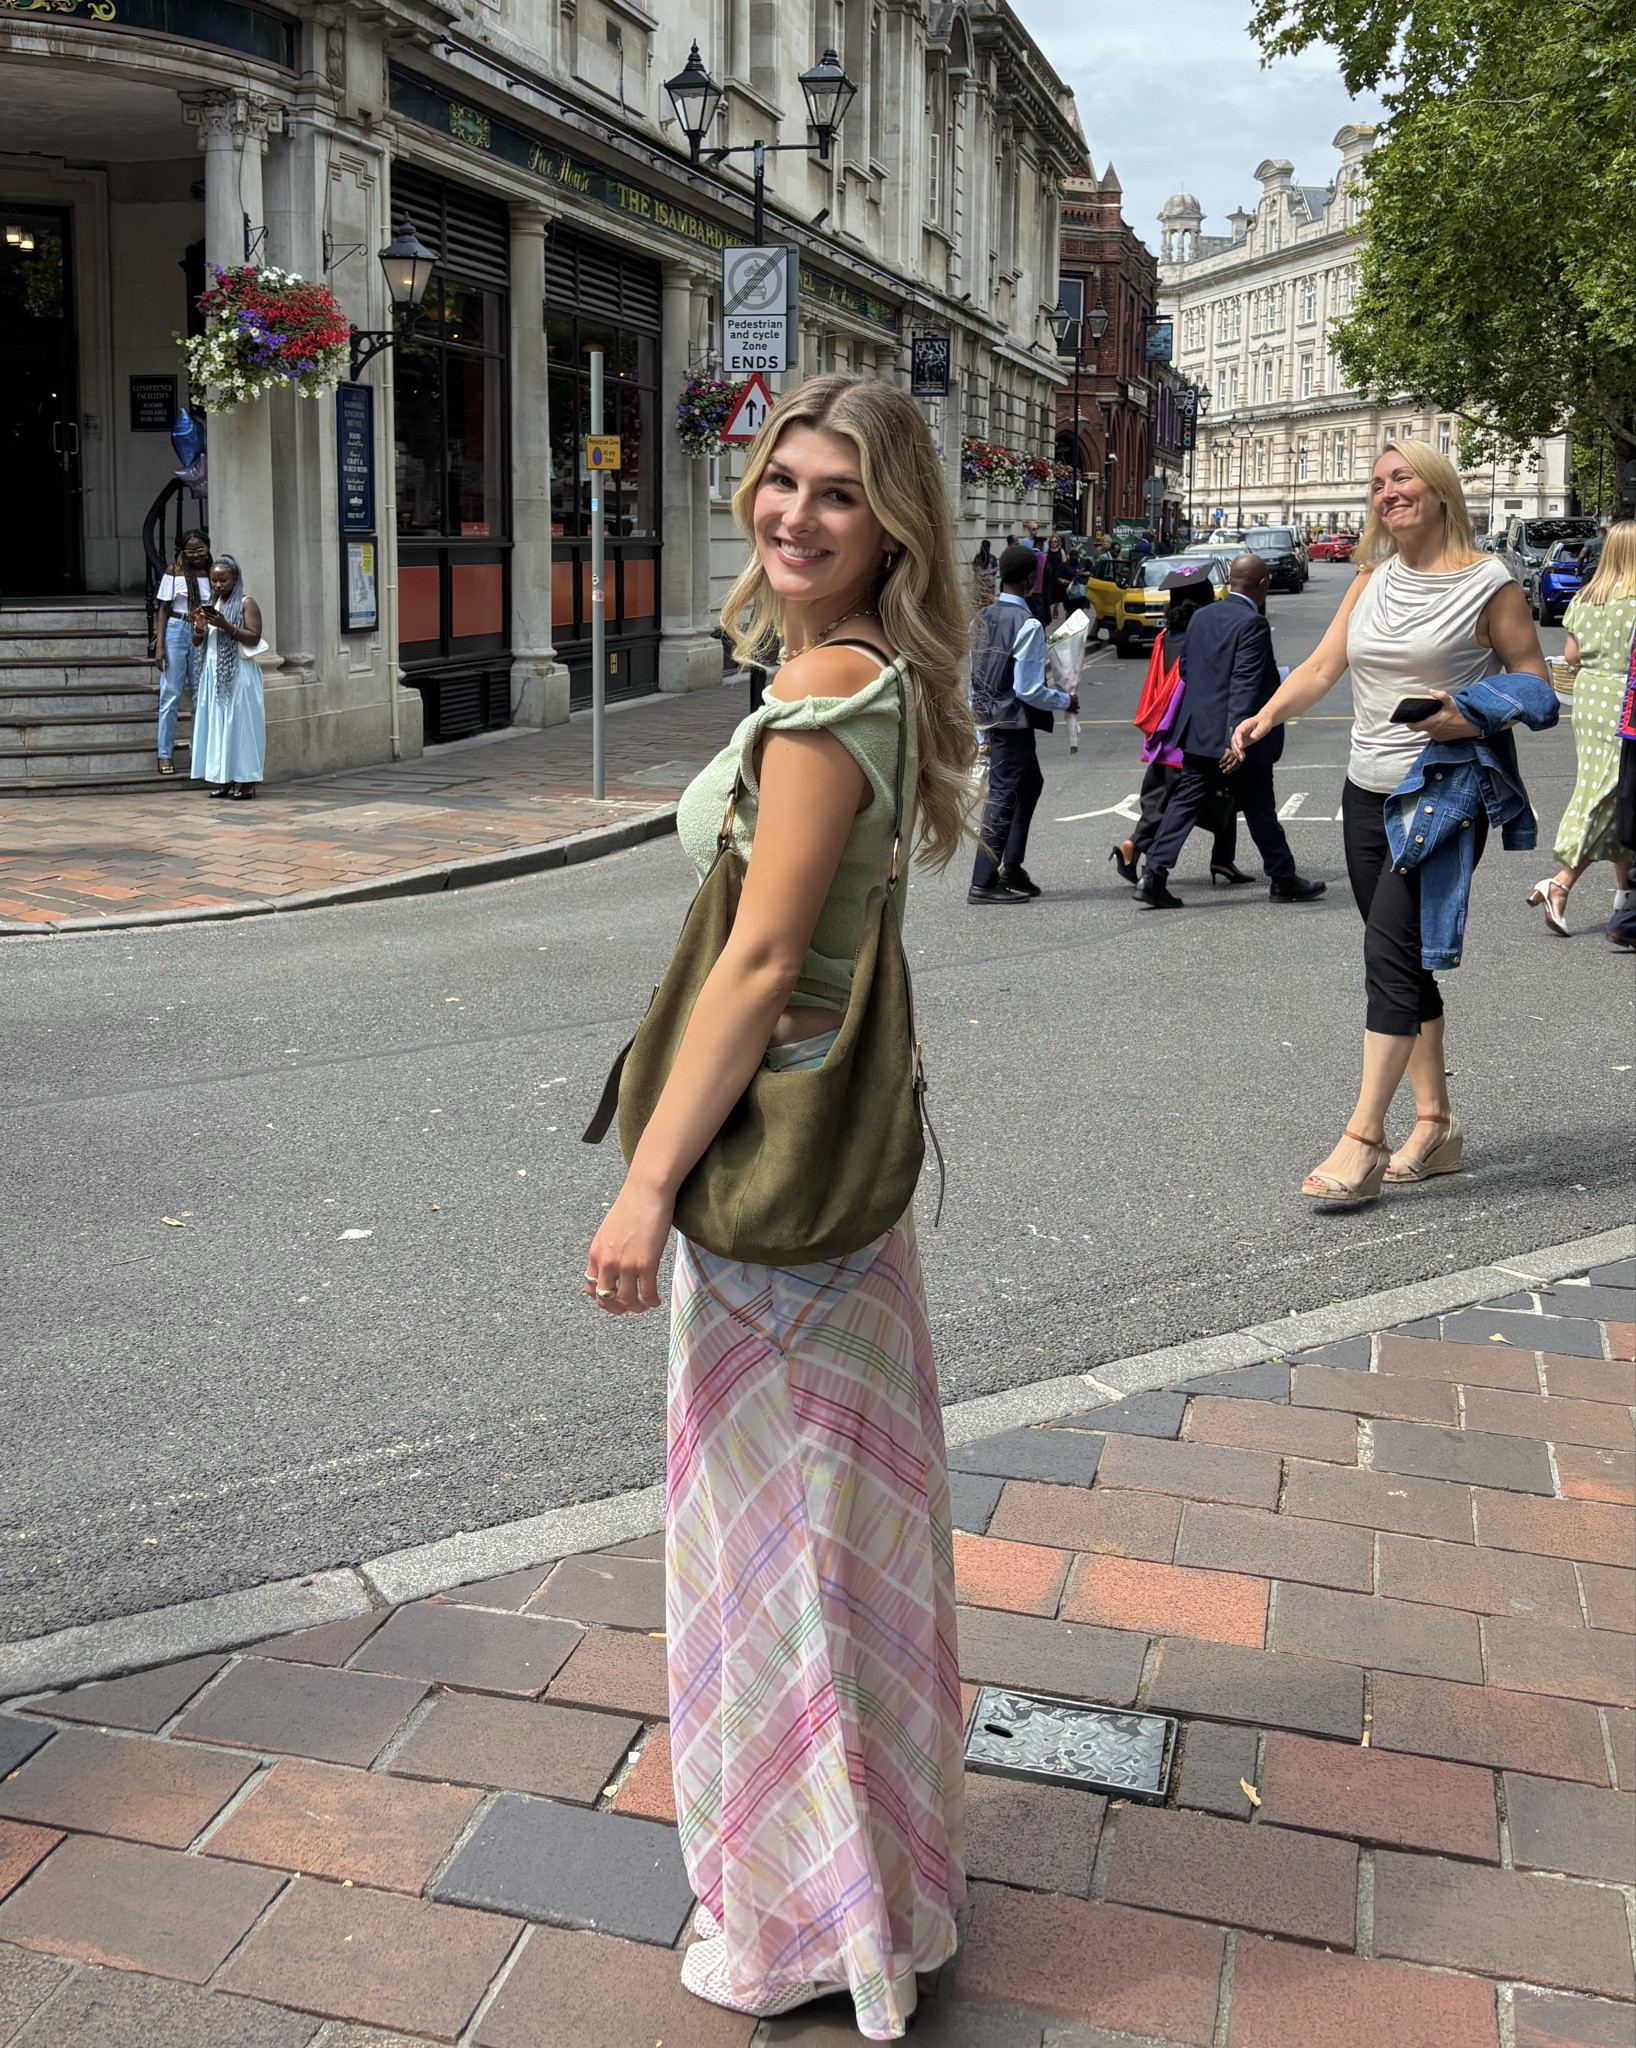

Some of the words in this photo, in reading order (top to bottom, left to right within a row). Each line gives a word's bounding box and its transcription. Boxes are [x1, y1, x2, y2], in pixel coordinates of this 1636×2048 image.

[528, 142, 554, 178] Free
[555, 154, 591, 194] House
[617, 182, 650, 219] THE
[654, 200, 723, 250] ISAMBARD
[728, 319, 783, 329] Pedestrian
[730, 330, 749, 339] and
[752, 330, 780, 340] cycle
[742, 341, 768, 351] Zone
[732, 356, 778, 369] ENDS
[349, 432, 361, 440] FOOD
